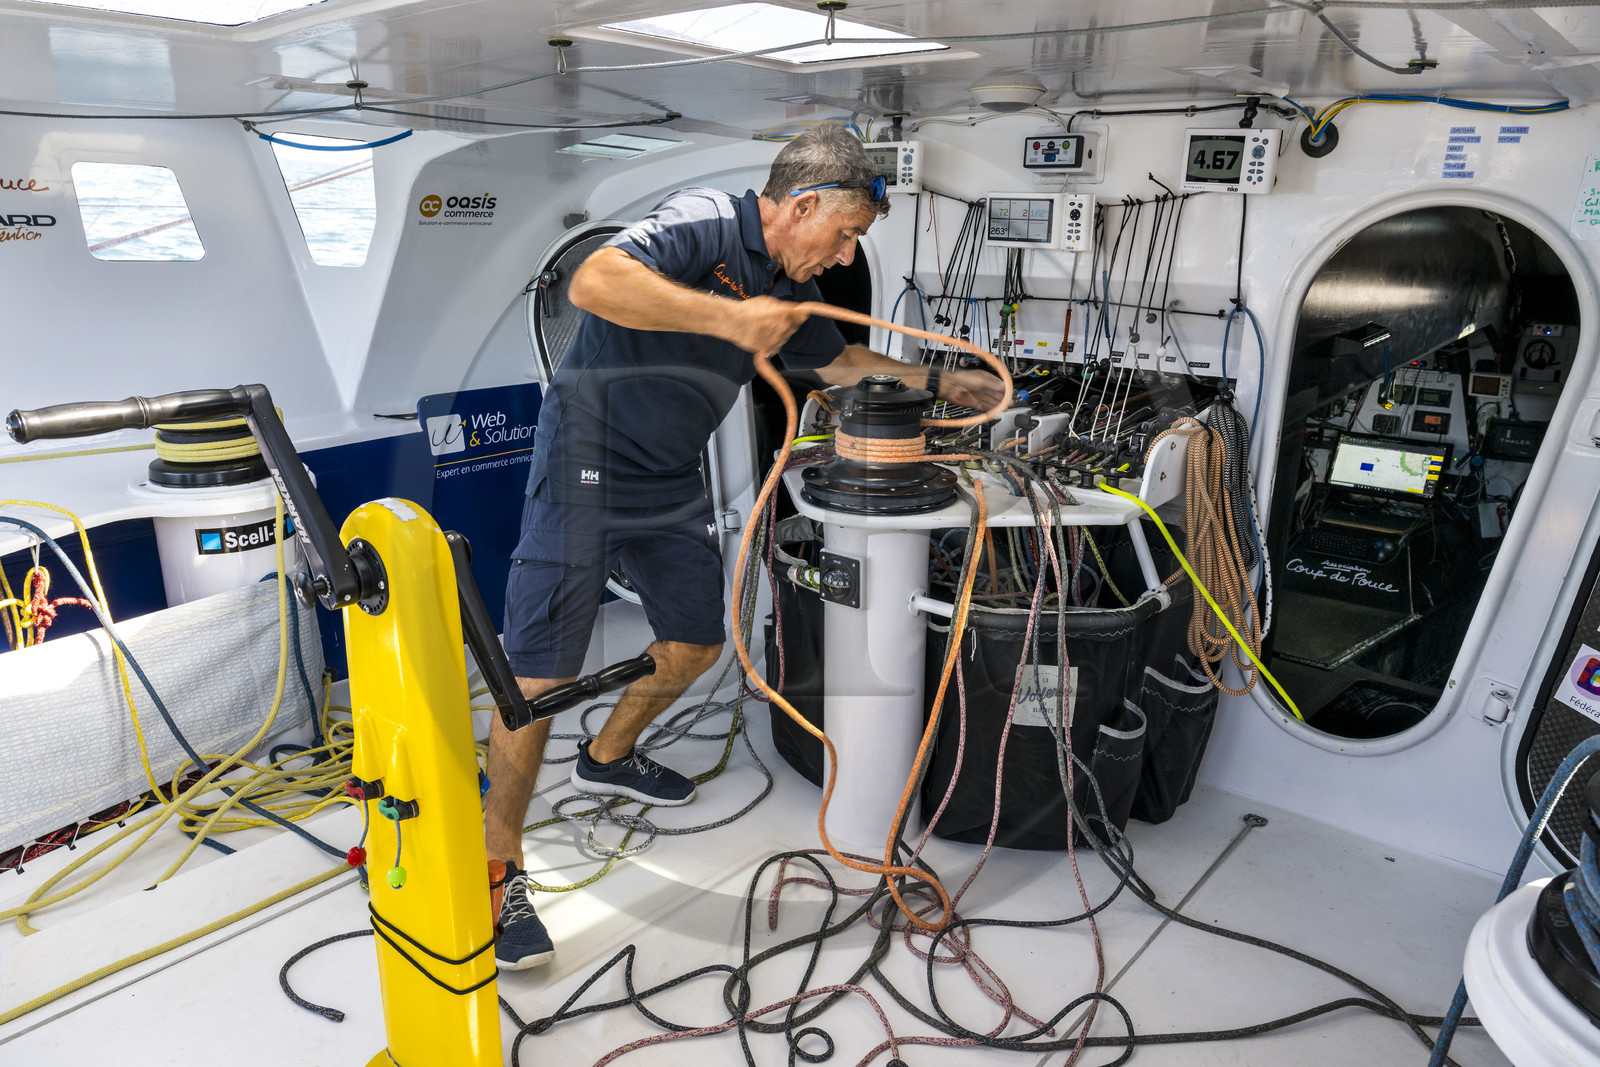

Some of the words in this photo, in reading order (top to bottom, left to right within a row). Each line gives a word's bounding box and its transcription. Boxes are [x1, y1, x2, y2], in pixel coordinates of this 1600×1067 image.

[1193, 150, 1240, 170] 4.67
[446, 192, 497, 209] oasis
[444, 210, 494, 218] commerce
[999, 208, 1009, 217] 72
[1022, 208, 1028, 217] 2
[471, 411, 506, 430] Web
[469, 430, 481, 447] &
[436, 464, 460, 480] Expert
[460, 463, 471, 475] en
[471, 458, 509, 473] commerce
[271, 468, 311, 544] HARKEN
[224, 522, 287, 549] Scell-i
[1286, 558, 1327, 580] Coup
[1329, 571, 1350, 582] de
[1351, 572, 1399, 592] Pouce
